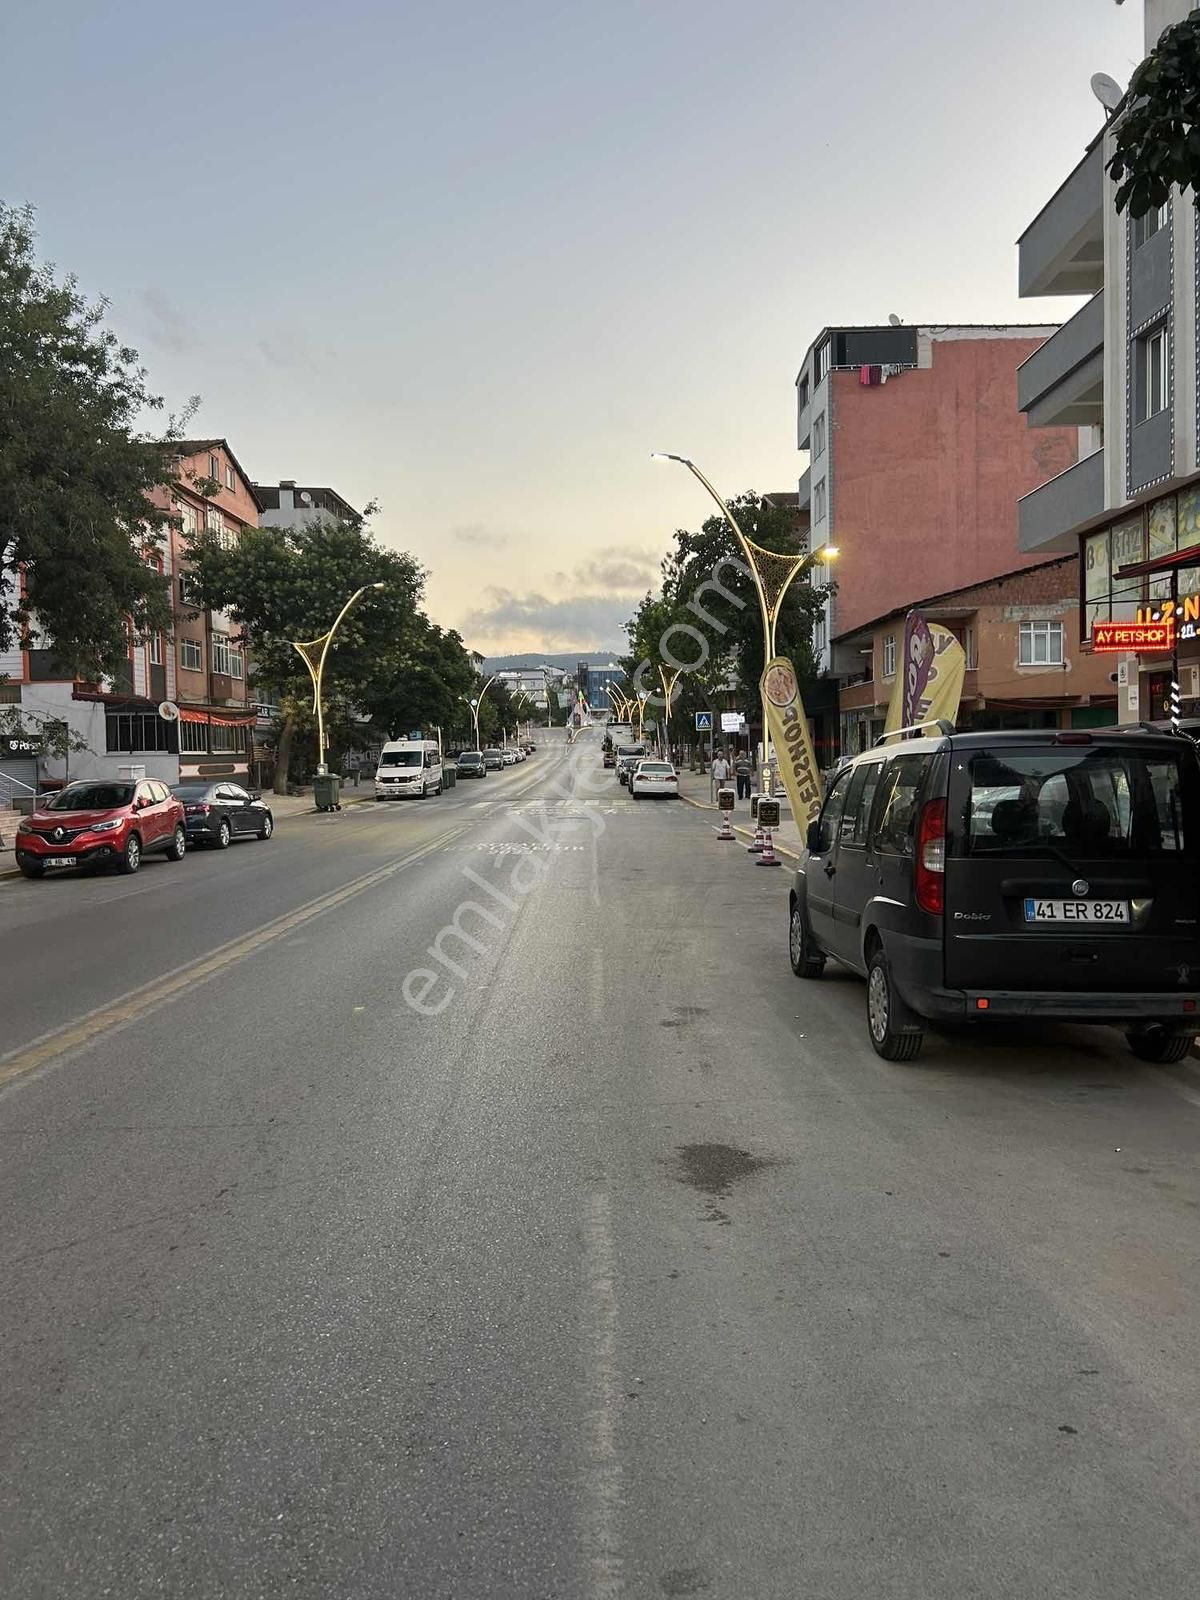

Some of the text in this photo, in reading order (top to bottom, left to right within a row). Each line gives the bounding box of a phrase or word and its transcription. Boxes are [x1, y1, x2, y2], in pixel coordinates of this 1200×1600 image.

[1097, 629, 1165, 643] AY PETSHOP
[1036, 902, 1124, 920] 41 ER 824
